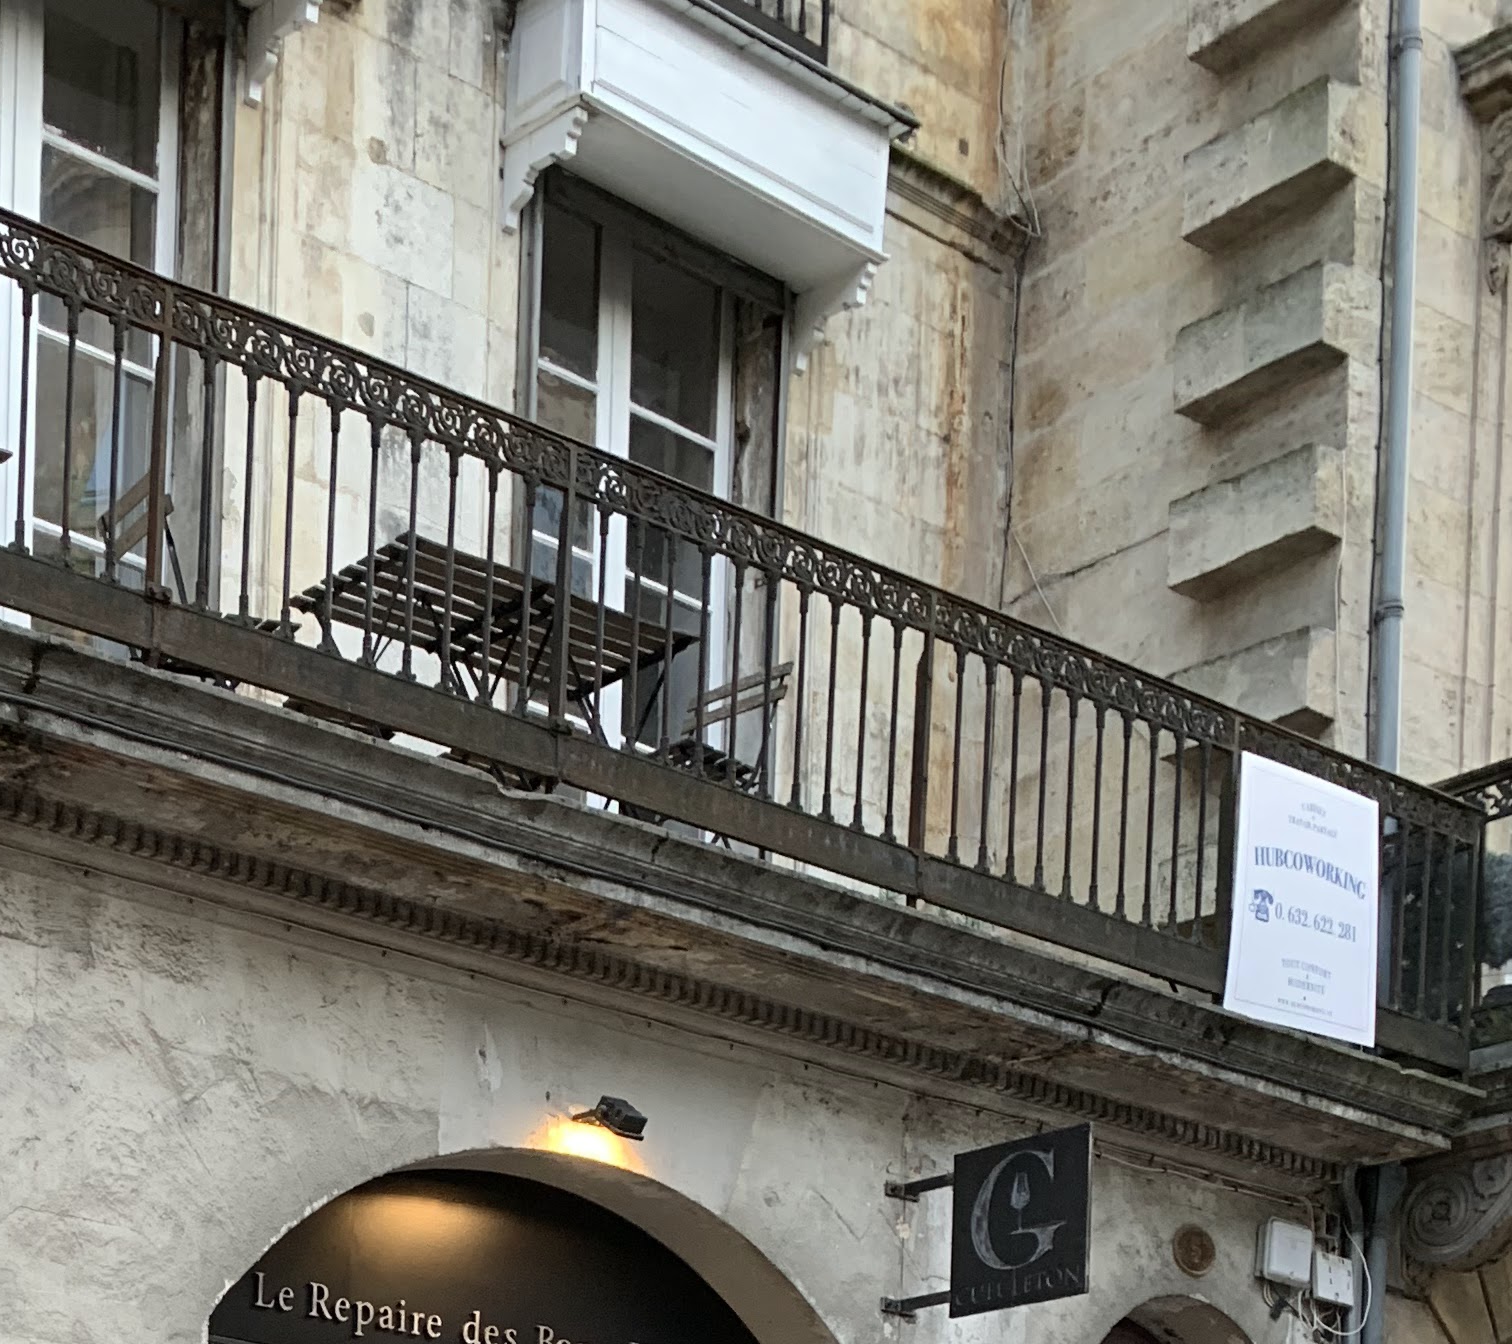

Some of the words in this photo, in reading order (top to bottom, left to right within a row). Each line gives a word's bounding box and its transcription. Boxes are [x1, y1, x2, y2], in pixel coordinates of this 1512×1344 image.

[1254, 846, 1367, 900] HUBCOWORKING
[1337, 921, 1357, 942] 281
[971, 1148, 1067, 1270] G
[254, 1271, 294, 1312] Le
[308, 1281, 443, 1338] Repaire
